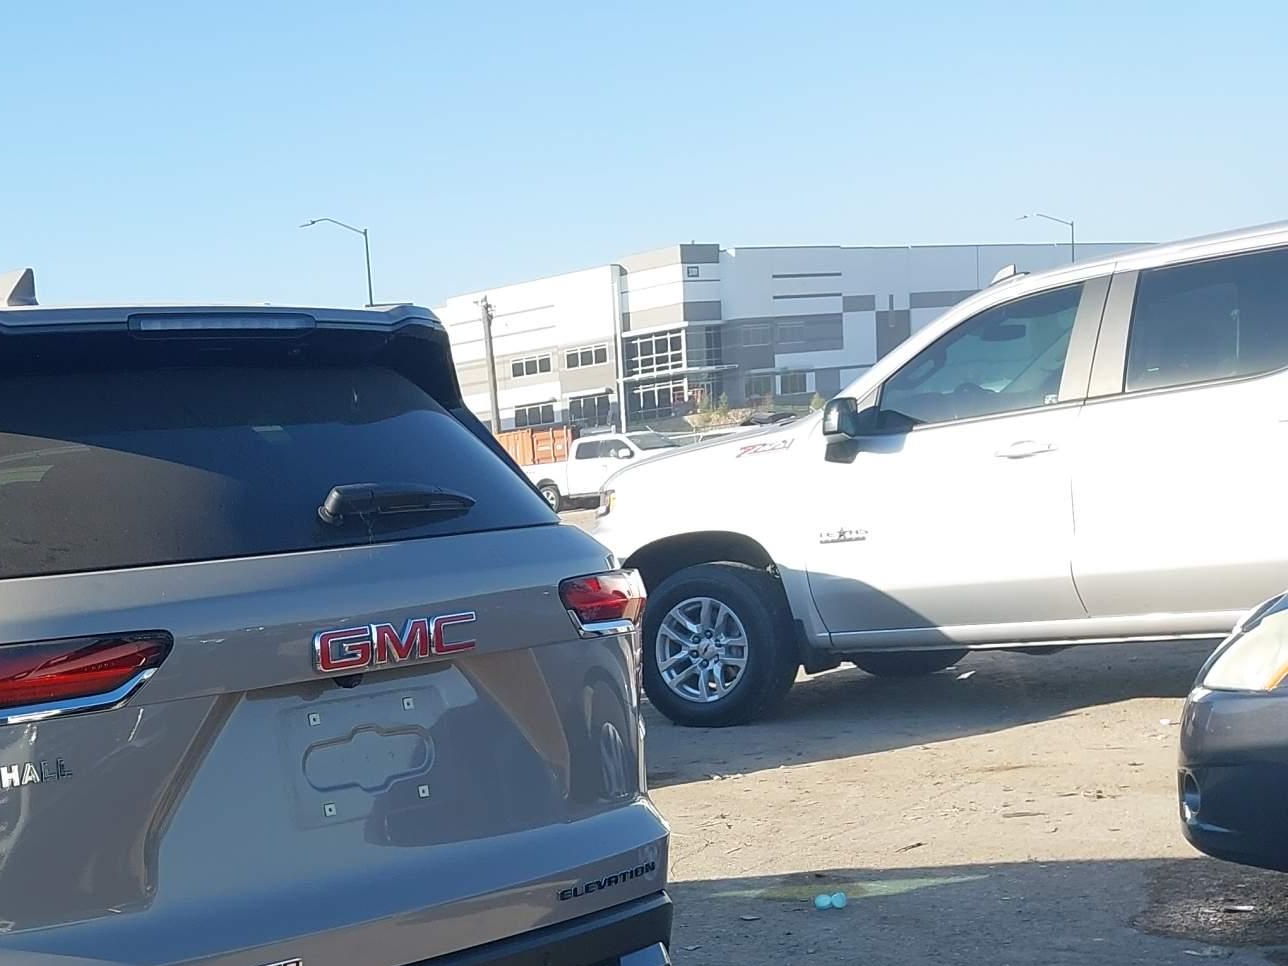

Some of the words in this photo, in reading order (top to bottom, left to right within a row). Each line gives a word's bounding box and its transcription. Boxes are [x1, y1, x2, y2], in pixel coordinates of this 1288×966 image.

[313, 611, 477, 672] GMC
[0, 758, 73, 789] HALL
[558, 861, 656, 901] ELEVATION
